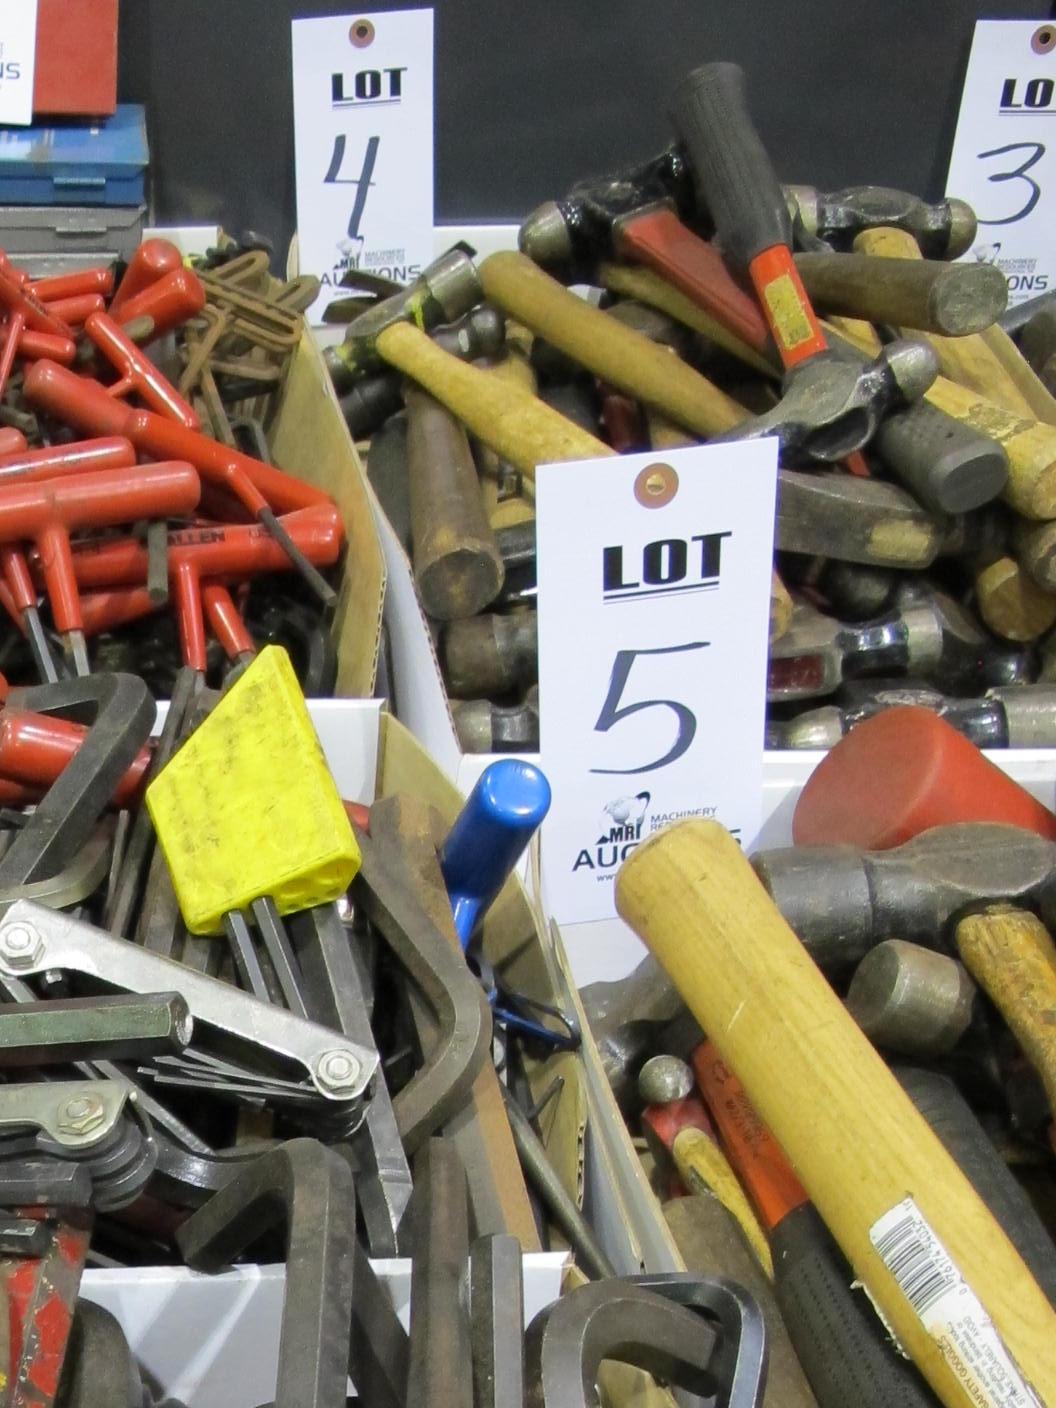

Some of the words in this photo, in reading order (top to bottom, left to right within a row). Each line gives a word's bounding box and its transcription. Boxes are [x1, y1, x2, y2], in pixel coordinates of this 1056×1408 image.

[331, 67, 408, 101] LOT
[999, 78, 1056, 108] LO
[323, 134, 380, 240] 4
[977, 142, 1046, 226] 3
[603, 531, 733, 591] LOT
[589, 640, 712, 775] 5
[609, 823, 642, 844] MRI
[935, 1334, 970, 1378] GOGGLES
